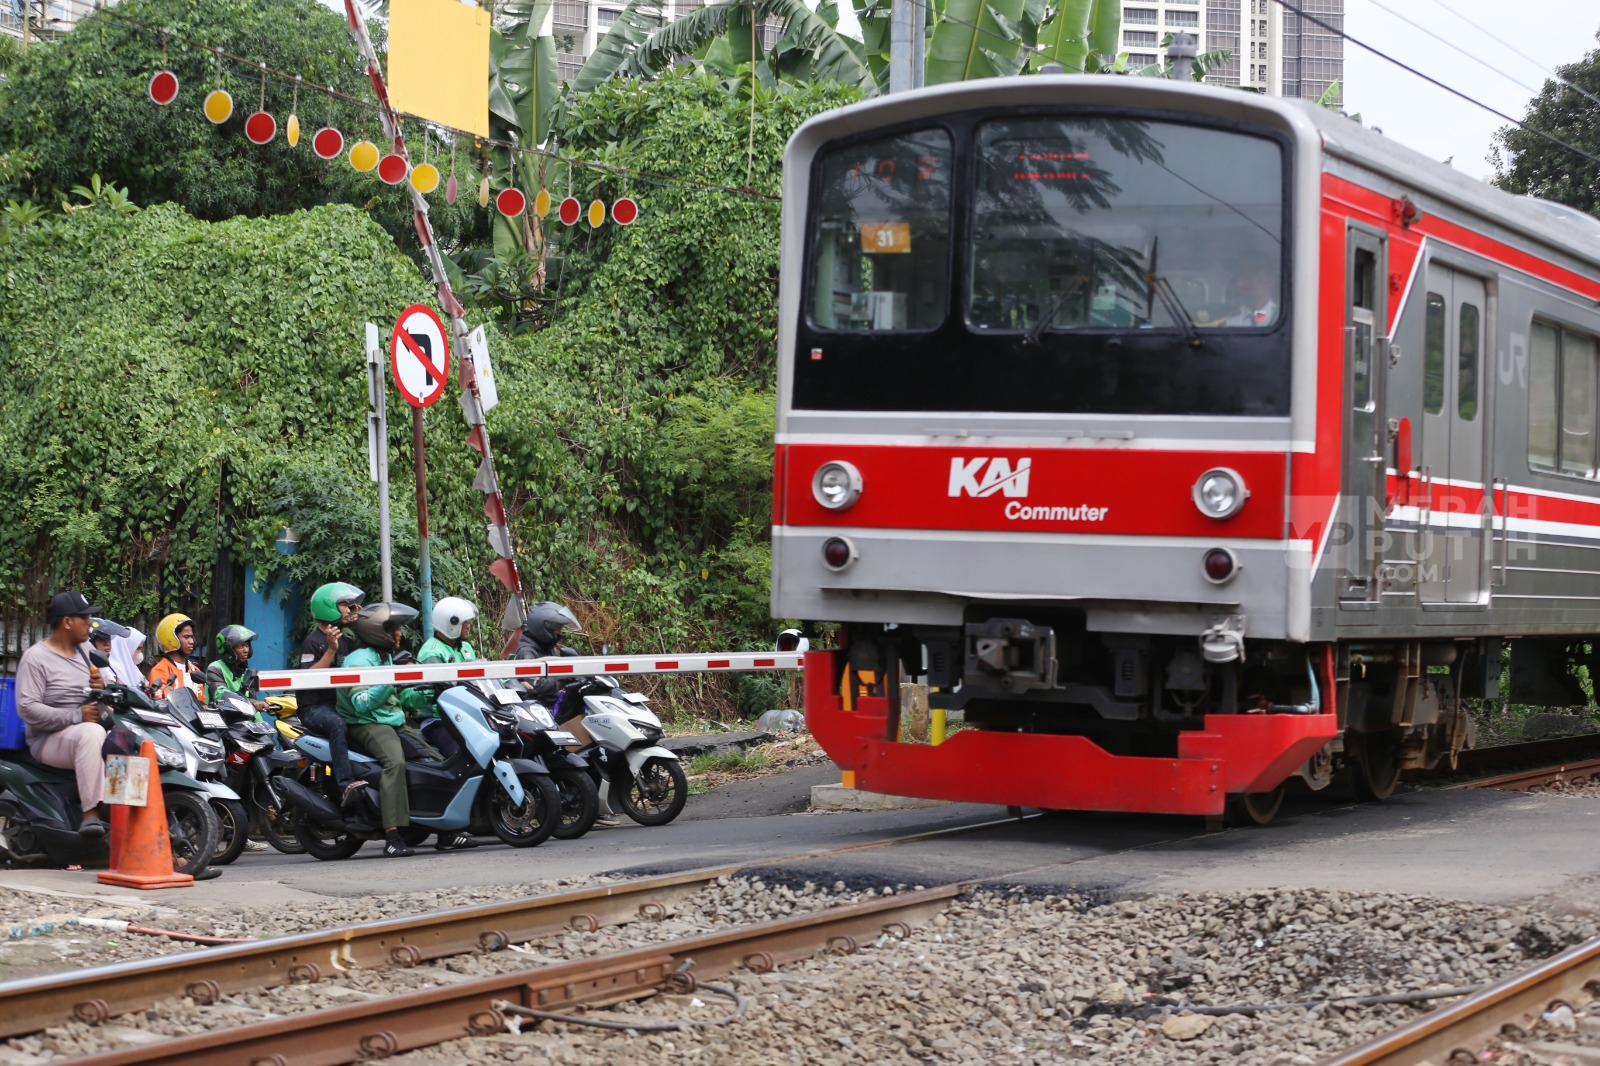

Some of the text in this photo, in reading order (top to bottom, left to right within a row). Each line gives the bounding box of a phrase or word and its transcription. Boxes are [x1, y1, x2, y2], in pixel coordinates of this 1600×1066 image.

[876, 229, 894, 247] 31
[1498, 332, 1527, 389] JR
[947, 457, 1032, 498] KAI
[1004, 501, 1108, 521] Commuter
